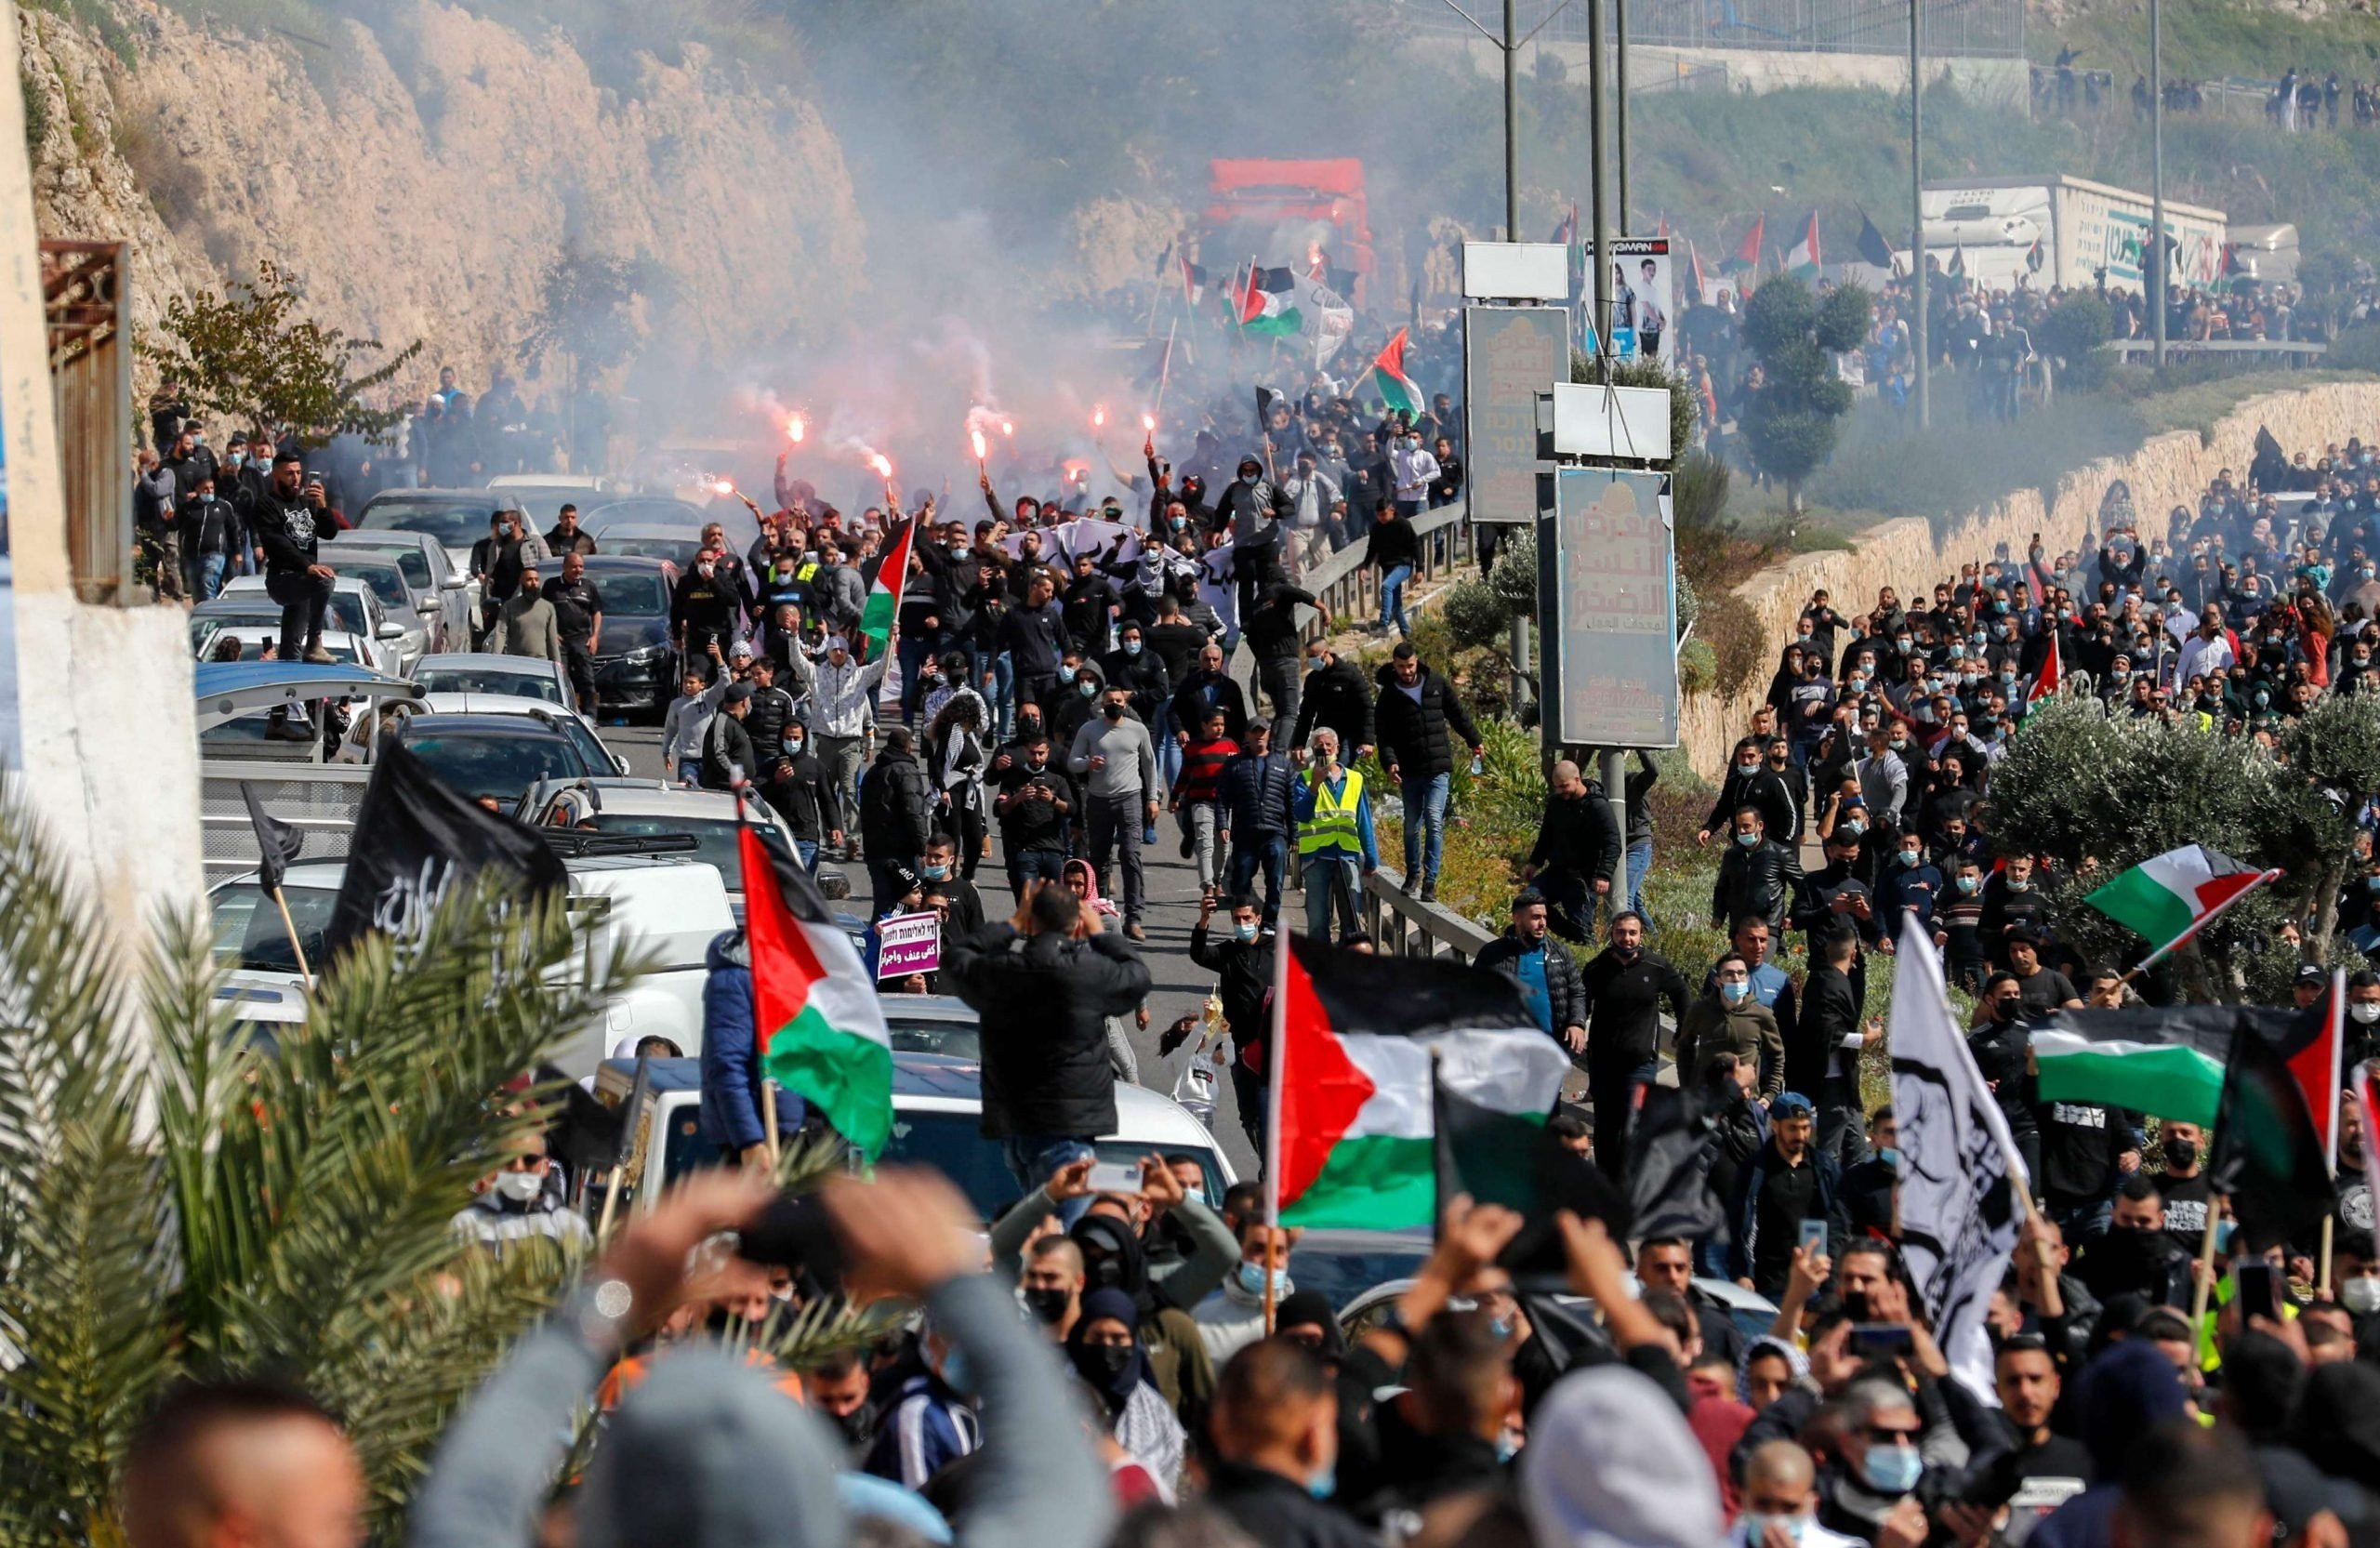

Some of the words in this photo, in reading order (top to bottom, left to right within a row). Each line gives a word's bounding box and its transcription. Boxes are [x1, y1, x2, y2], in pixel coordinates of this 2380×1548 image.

[899, 923, 925, 939] לאלימות
[927, 924, 934, 935] די
[904, 949, 921, 962] عنف
